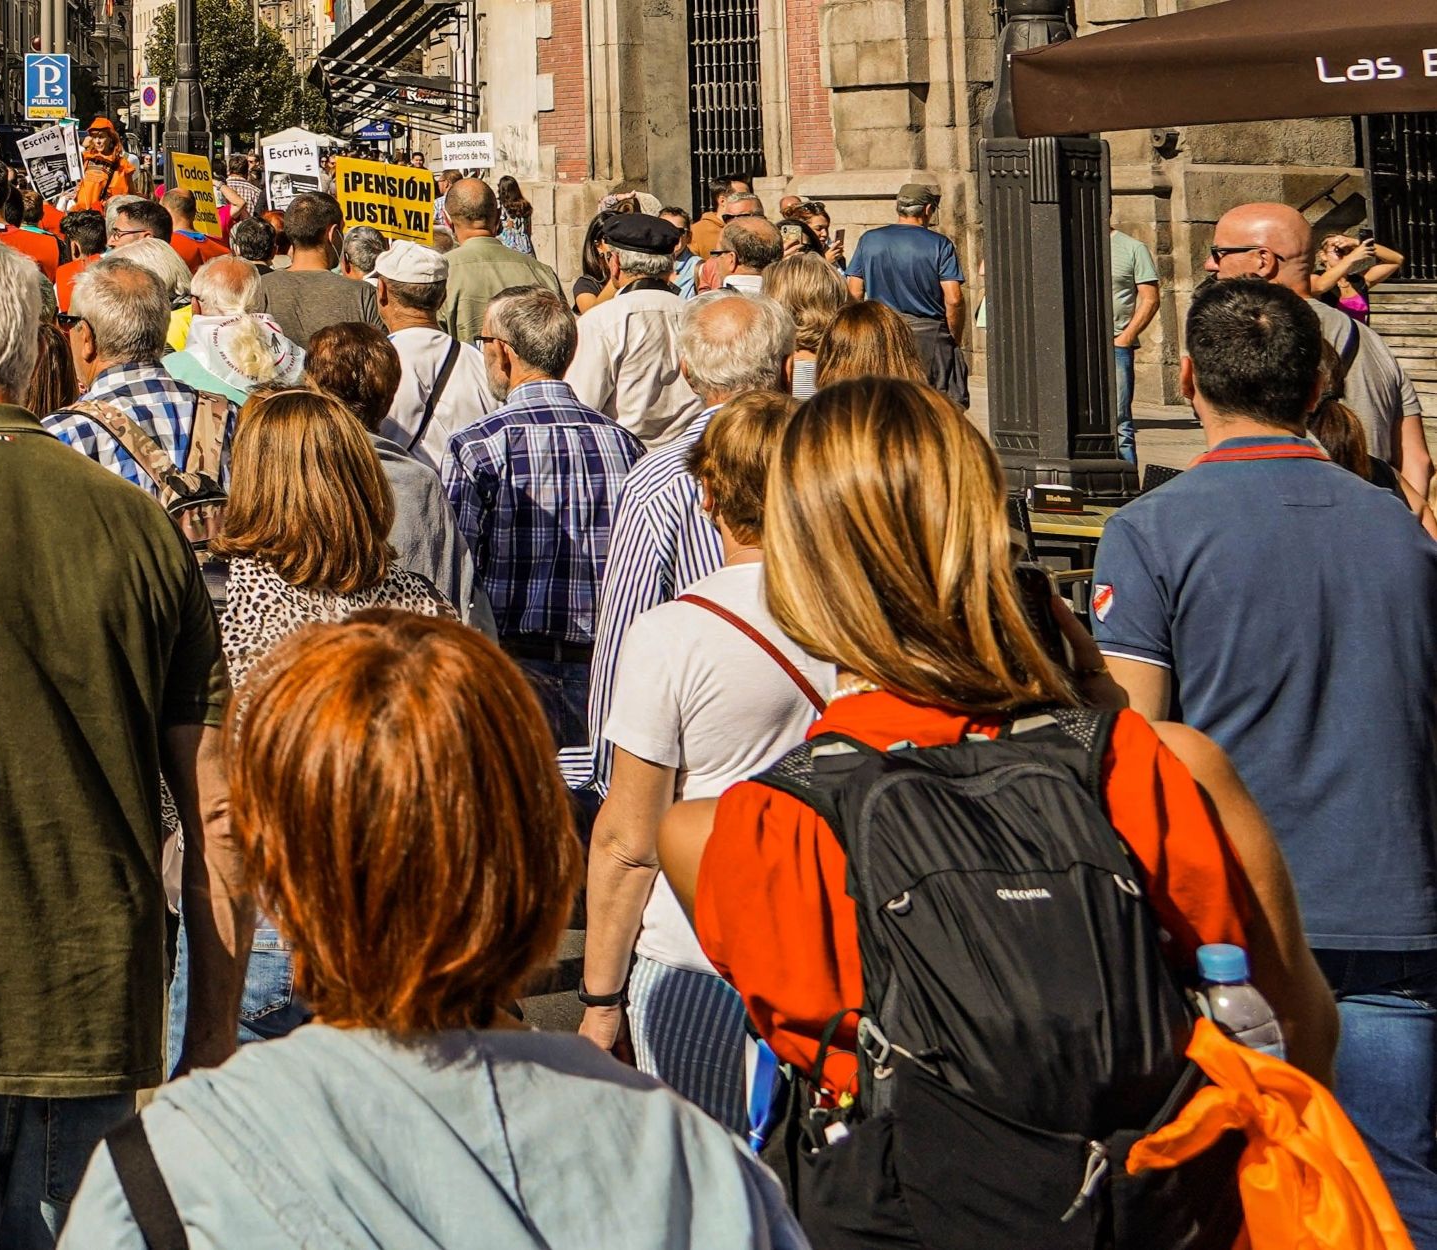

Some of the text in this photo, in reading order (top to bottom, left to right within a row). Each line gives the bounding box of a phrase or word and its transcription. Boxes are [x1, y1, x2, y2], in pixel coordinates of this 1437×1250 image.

[35, 65, 61, 98] P
[1315, 56, 1403, 83] Las
[445, 138, 487, 149] Las pensiones,
[449, 152, 470, 163] precios
[470, 151, 478, 160] de
[478, 150, 492, 163] hoy.
[177, 164, 210, 181] Todos
[343, 171, 432, 203] ¡PENSIÓN
[345, 200, 430, 233] JUSTA, YA!
